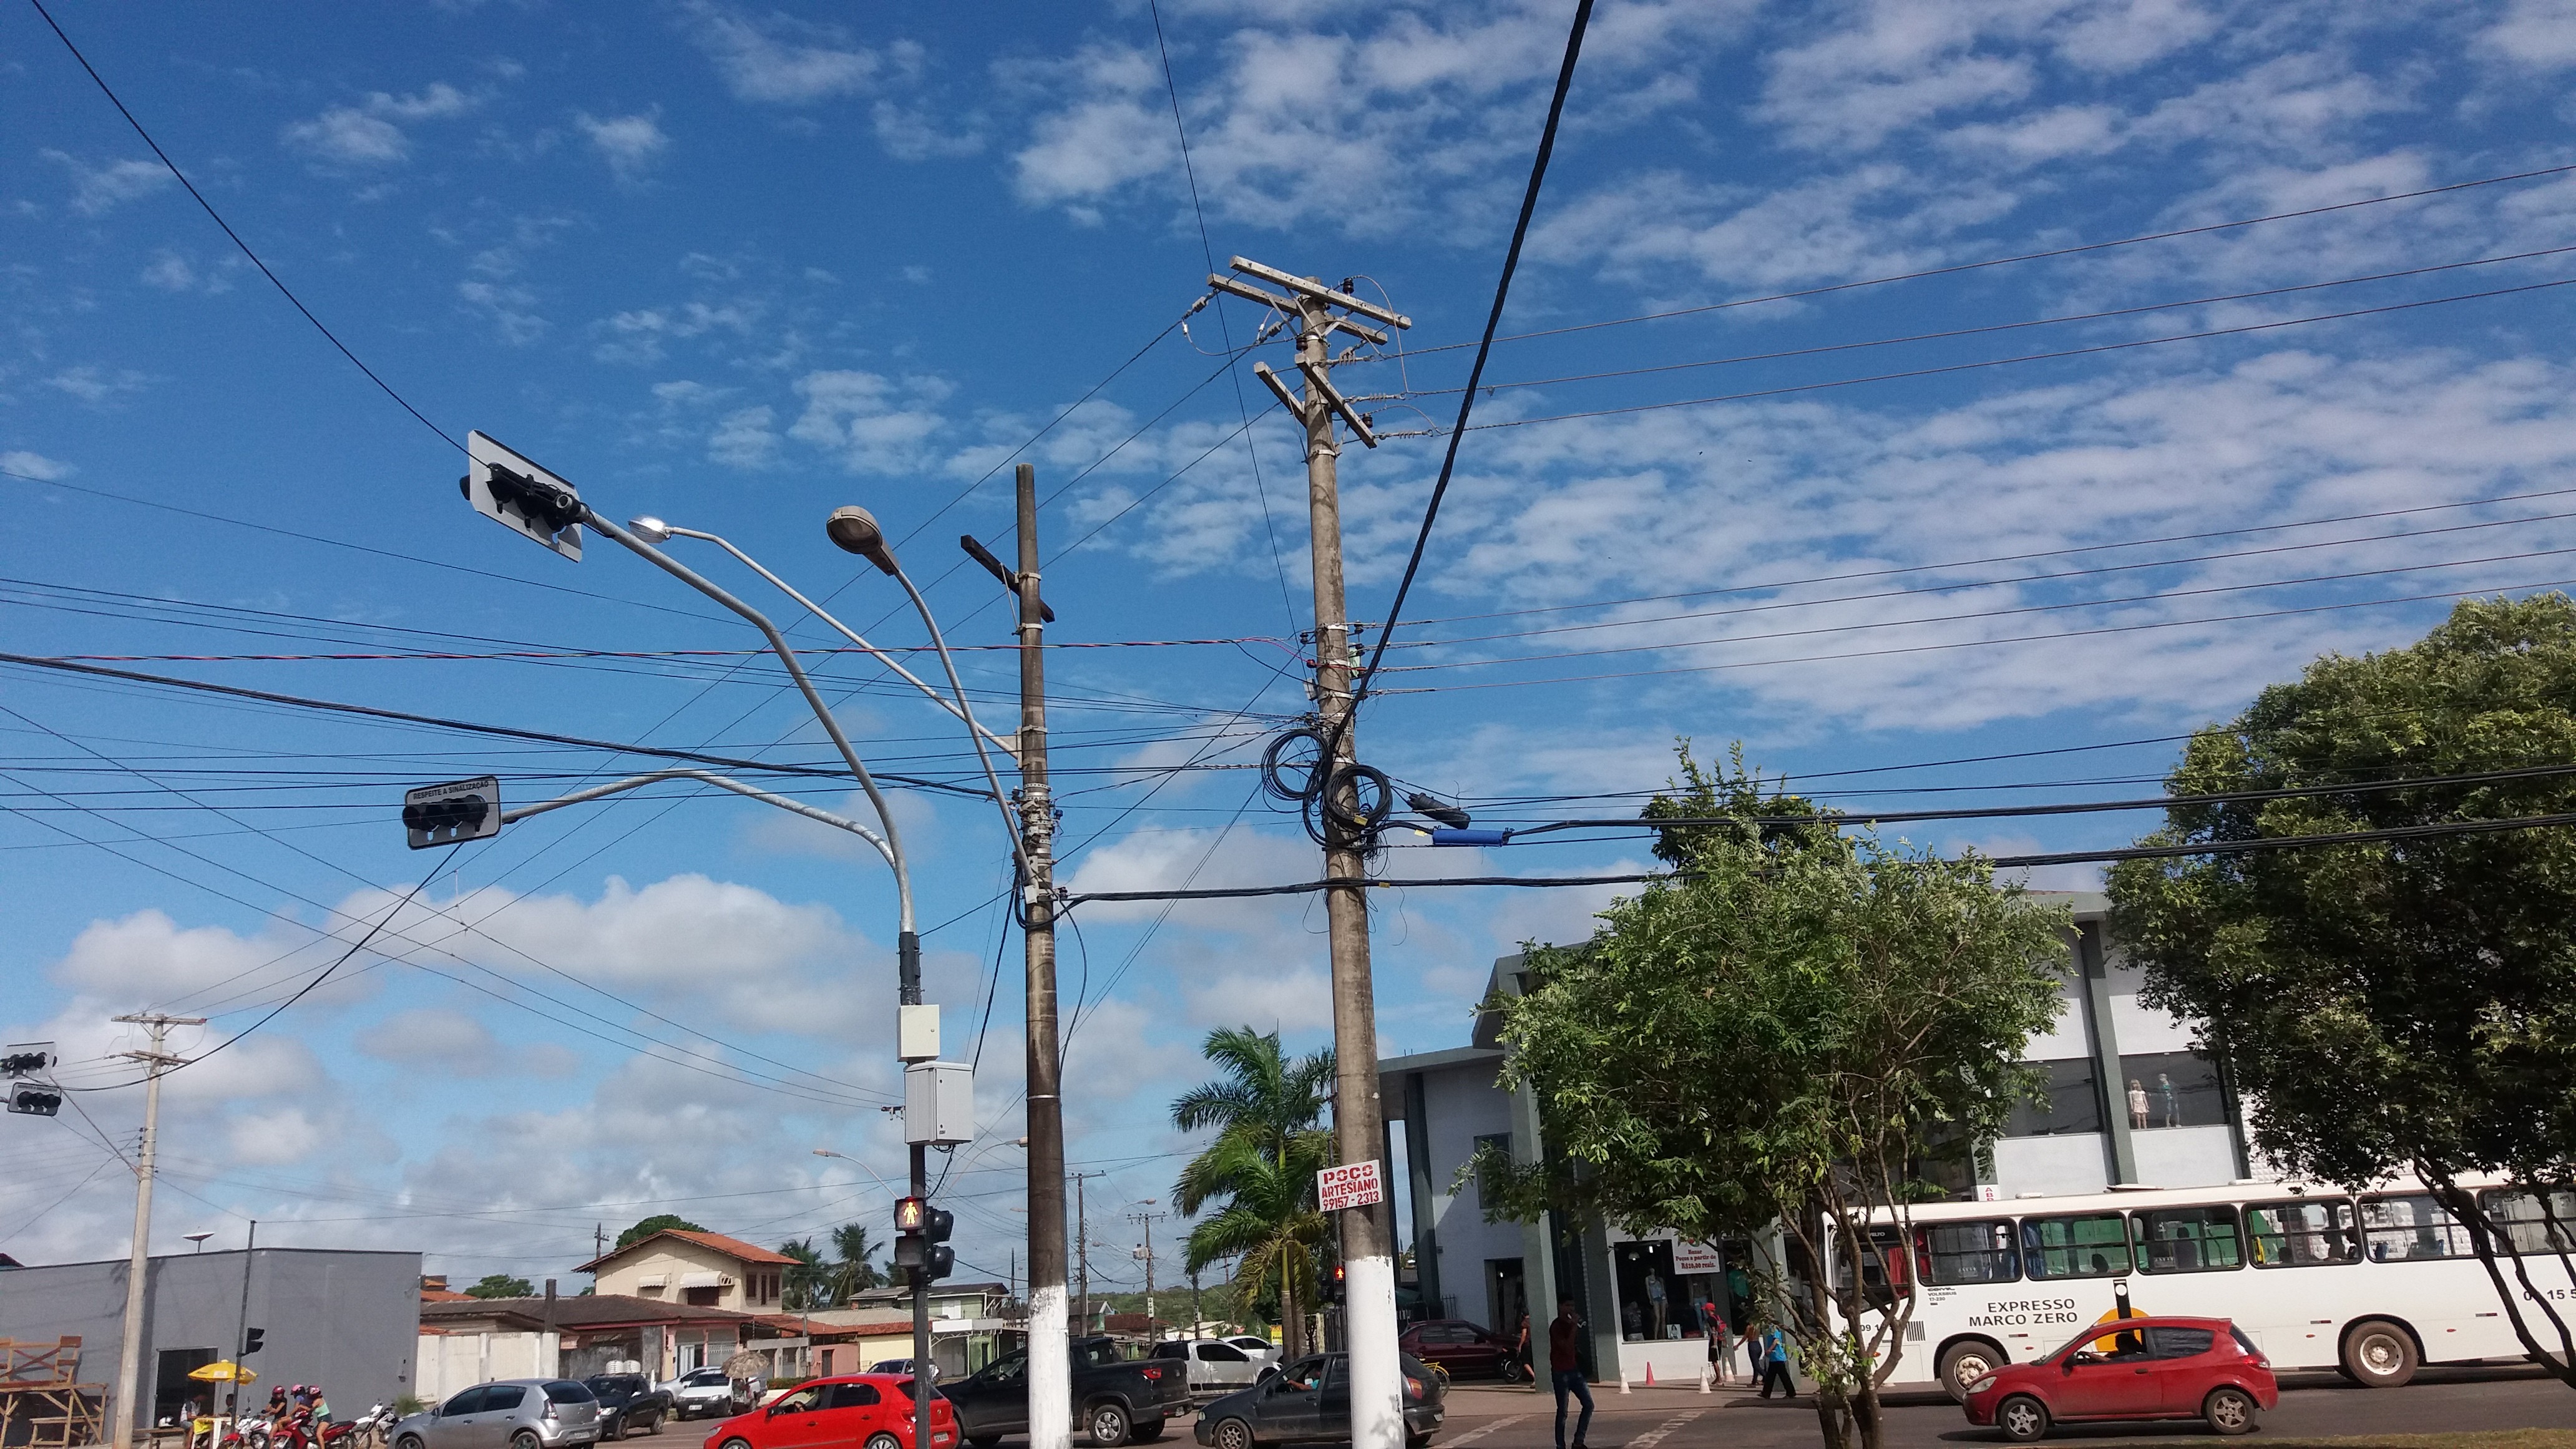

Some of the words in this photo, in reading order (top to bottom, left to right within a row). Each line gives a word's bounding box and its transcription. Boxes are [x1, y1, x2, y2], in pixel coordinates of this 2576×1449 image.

[413, 789, 442, 799] RESPEITE
[1323, 1164, 1373, 1184] POÇO
[1322, 1178, 1378, 1199] ARTESIANO
[1322, 1196, 1349, 1211] 99157
[1357, 1191, 1379, 1205] 2313
[2547, 1289, 2565, 1299] 15
[1988, 1299, 2075, 1312] EXPRESSO
[1969, 1314, 2027, 1327] MARCO
[2033, 1312, 2078, 1324] ZERO
